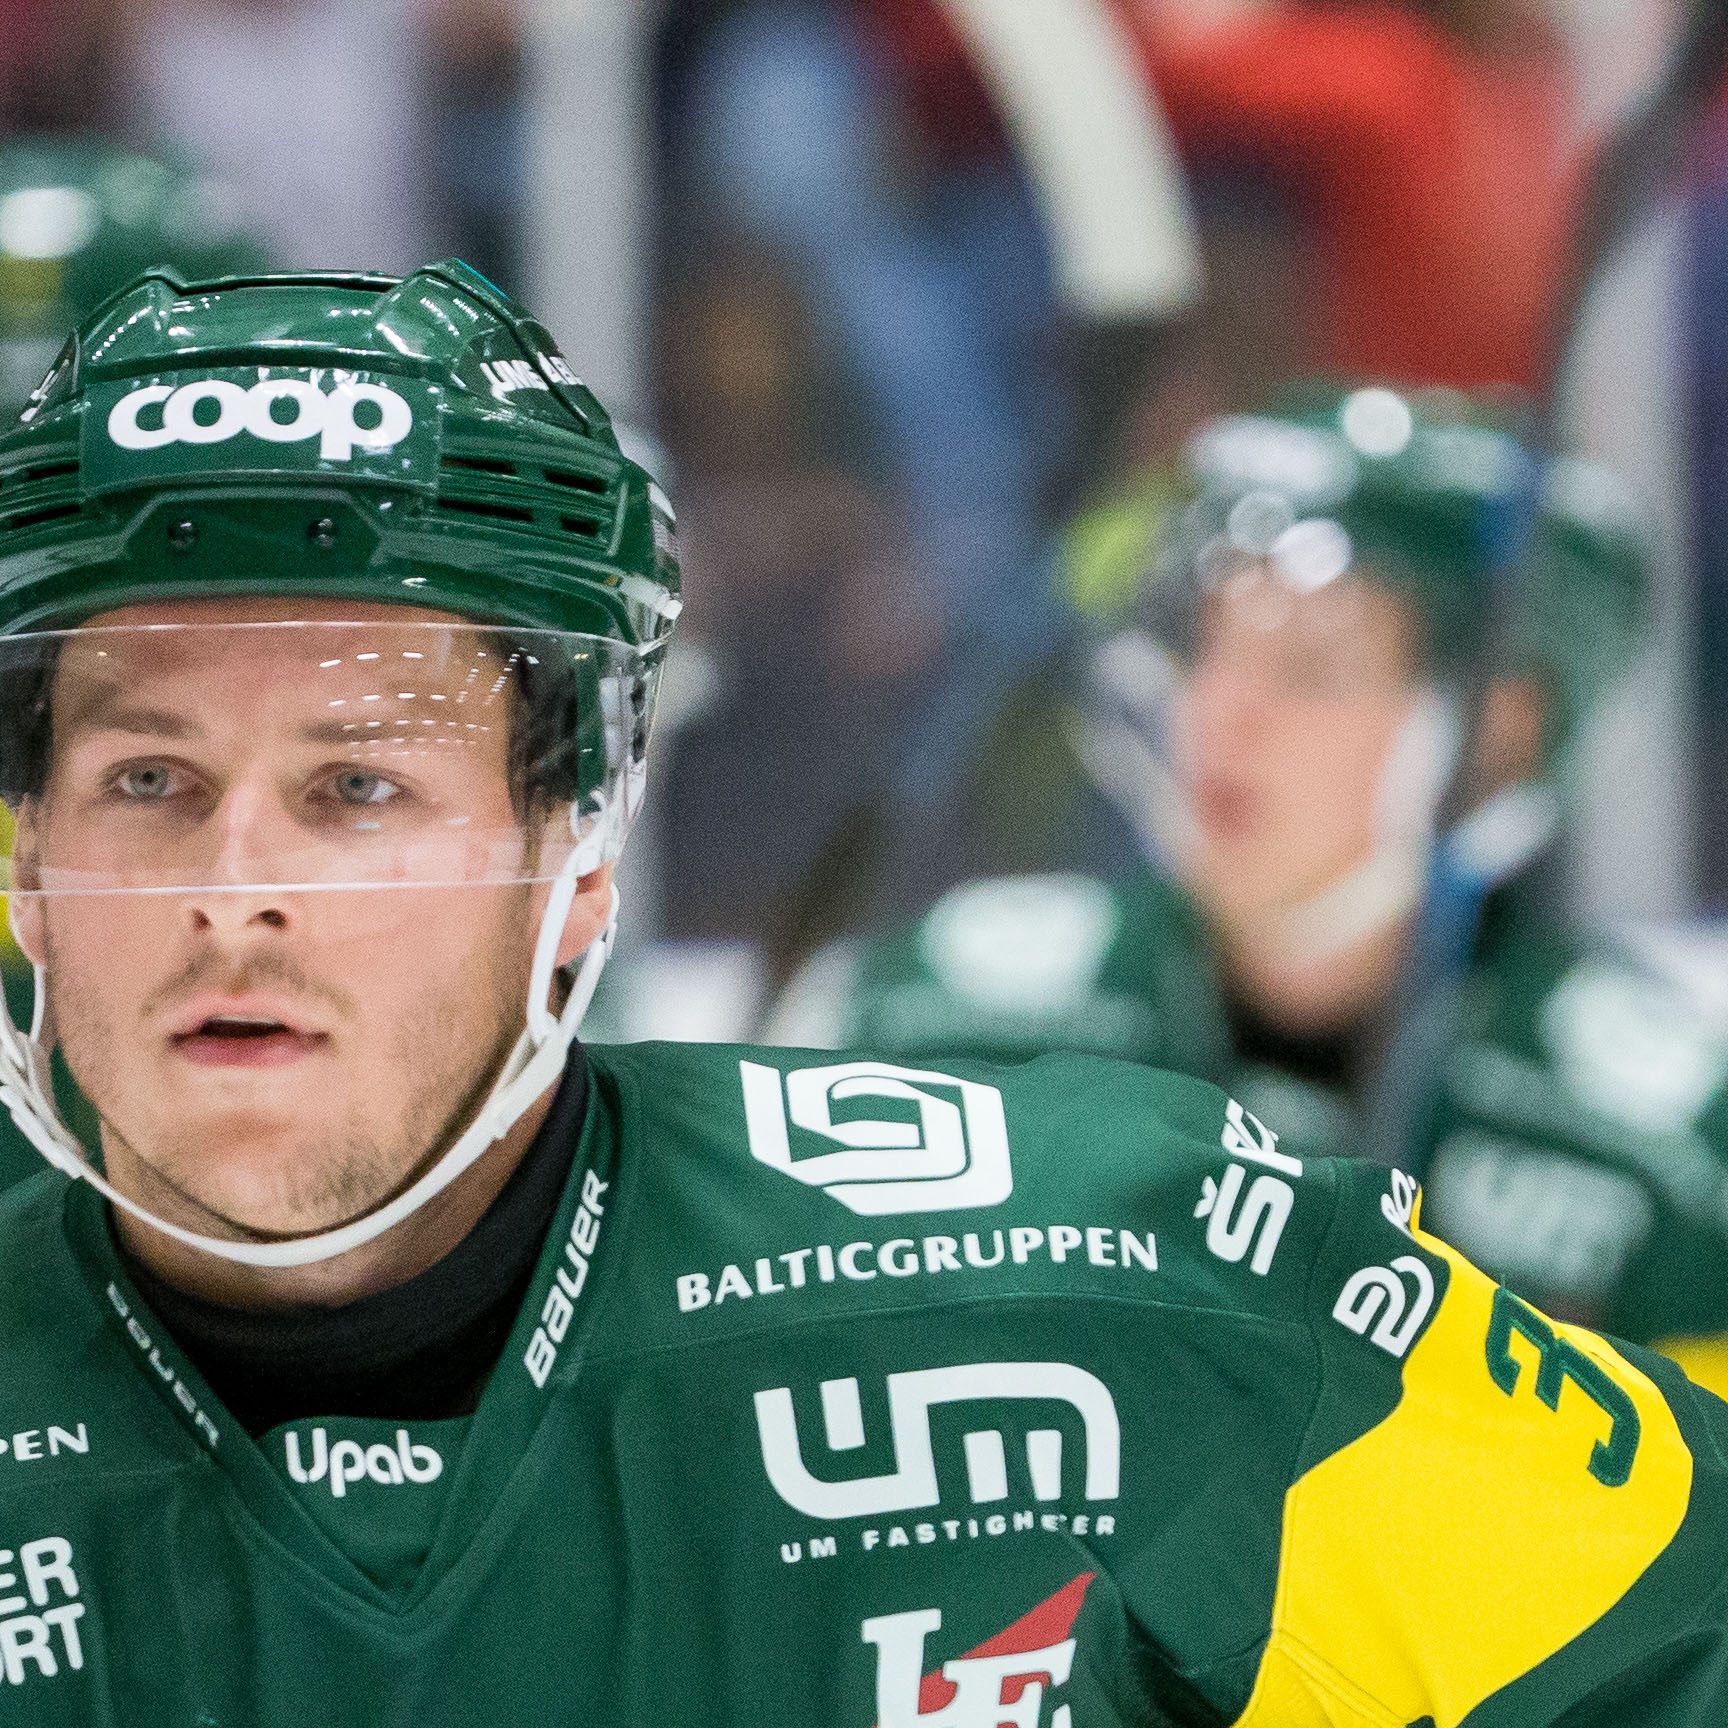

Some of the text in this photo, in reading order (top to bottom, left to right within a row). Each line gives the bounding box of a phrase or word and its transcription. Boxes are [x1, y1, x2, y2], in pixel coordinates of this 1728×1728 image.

[108, 379, 413, 461] coop
[676, 1225, 1159, 1313] BALTICGRUPPEN
[284, 1427, 445, 1498] Upab
[779, 1536, 838, 1564] UM
